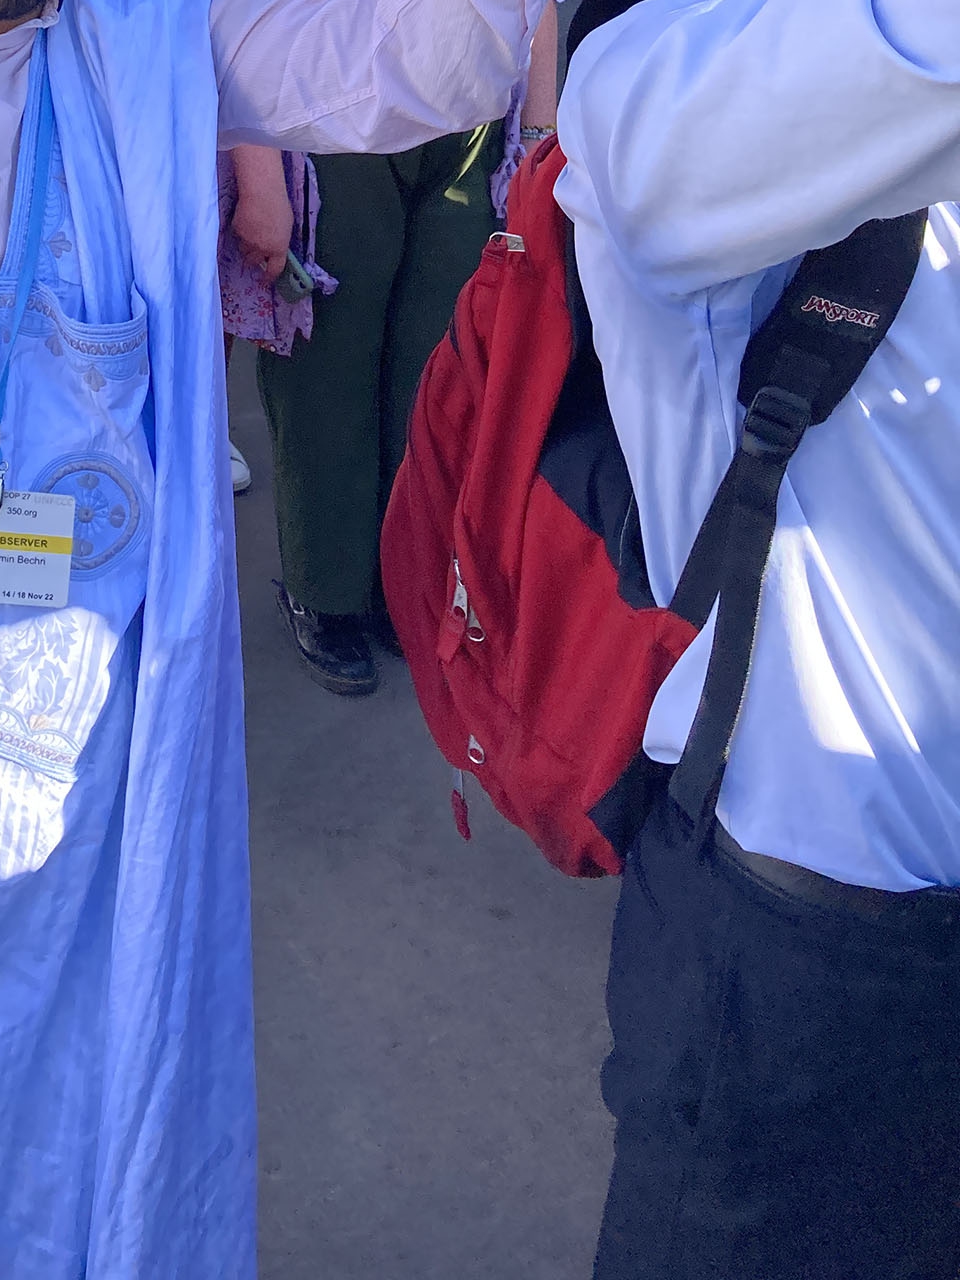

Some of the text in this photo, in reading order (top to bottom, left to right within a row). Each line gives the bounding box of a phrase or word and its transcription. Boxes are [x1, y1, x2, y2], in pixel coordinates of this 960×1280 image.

[7, 507, 38, 518] 350.org
[27, 592, 43, 600] Nov
[44, 593, 54, 601] 22
